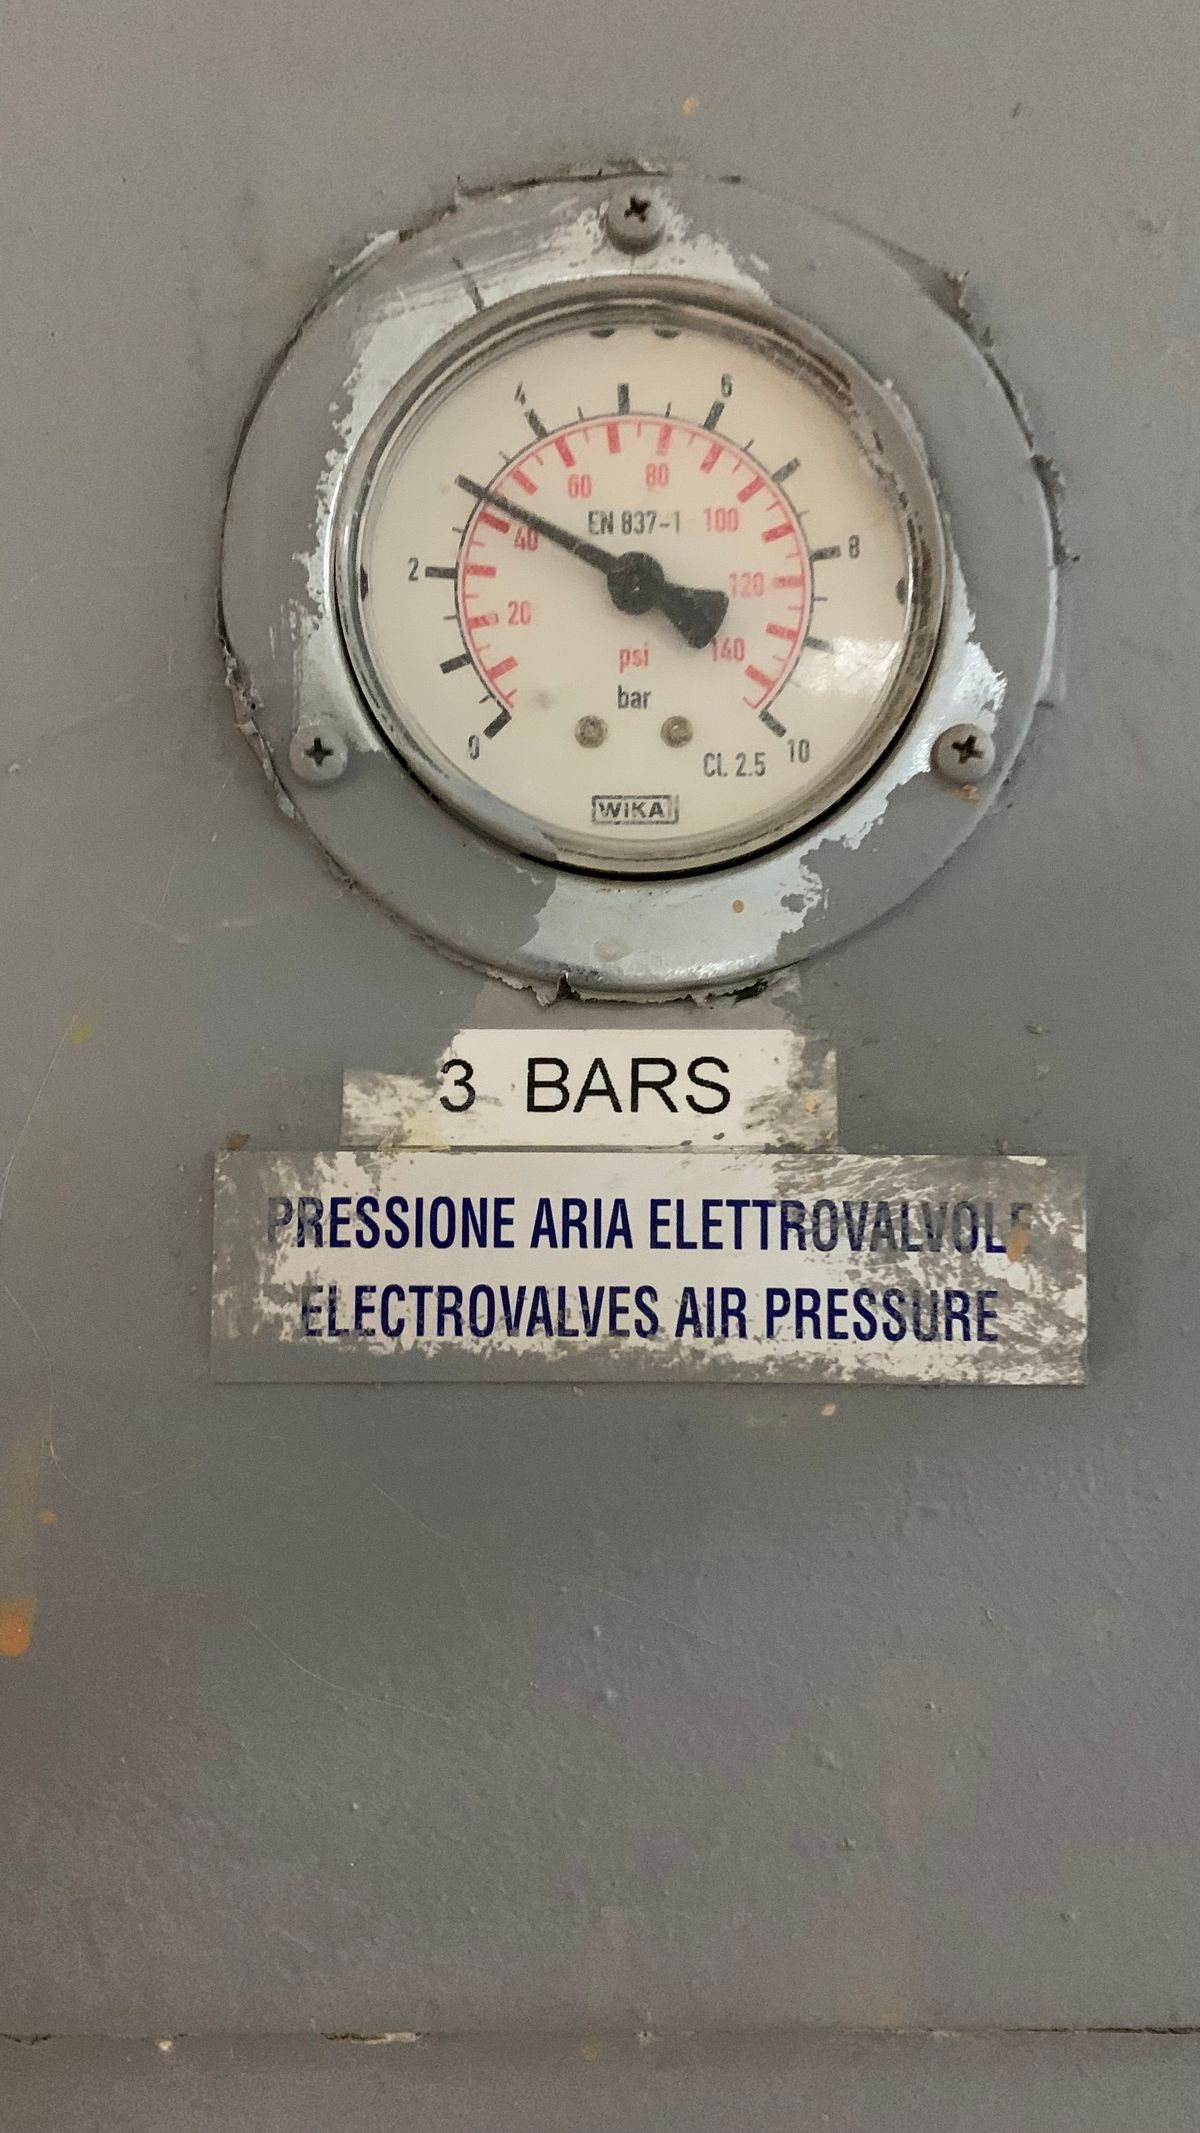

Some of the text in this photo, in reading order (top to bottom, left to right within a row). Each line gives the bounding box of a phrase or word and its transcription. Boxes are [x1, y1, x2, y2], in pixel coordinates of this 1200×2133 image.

[513, 381, 529, 405] 4
[720, 373, 733, 398] 6
[568, 475, 592, 497] 60
[645, 464, 670, 488] 80
[588, 511, 681, 534] EN 837-1
[704, 508, 739, 532] 100
[514, 530, 539, 551] 40
[848, 535, 861, 559] 8
[407, 557, 419, 582] 2
[729, 573, 764, 597] 120
[508, 601, 532, 624] 20
[618, 643, 650, 674] psi
[709, 638, 745, 663] 140
[617, 686, 652, 710] bar
[467, 735, 481, 761] 0
[789, 740, 810, 763] 10
[736, 752, 766, 777] 2.5
[598, 801, 666, 819] WIKA
[439, 1057, 731, 1114] 3 BARS
[267, 1196, 515, 1249] PRESSIONE
[530, 1198, 633, 1249] ARIA
[301, 1284, 999, 1342] ELECTROVALVES AIR PRESSURE
